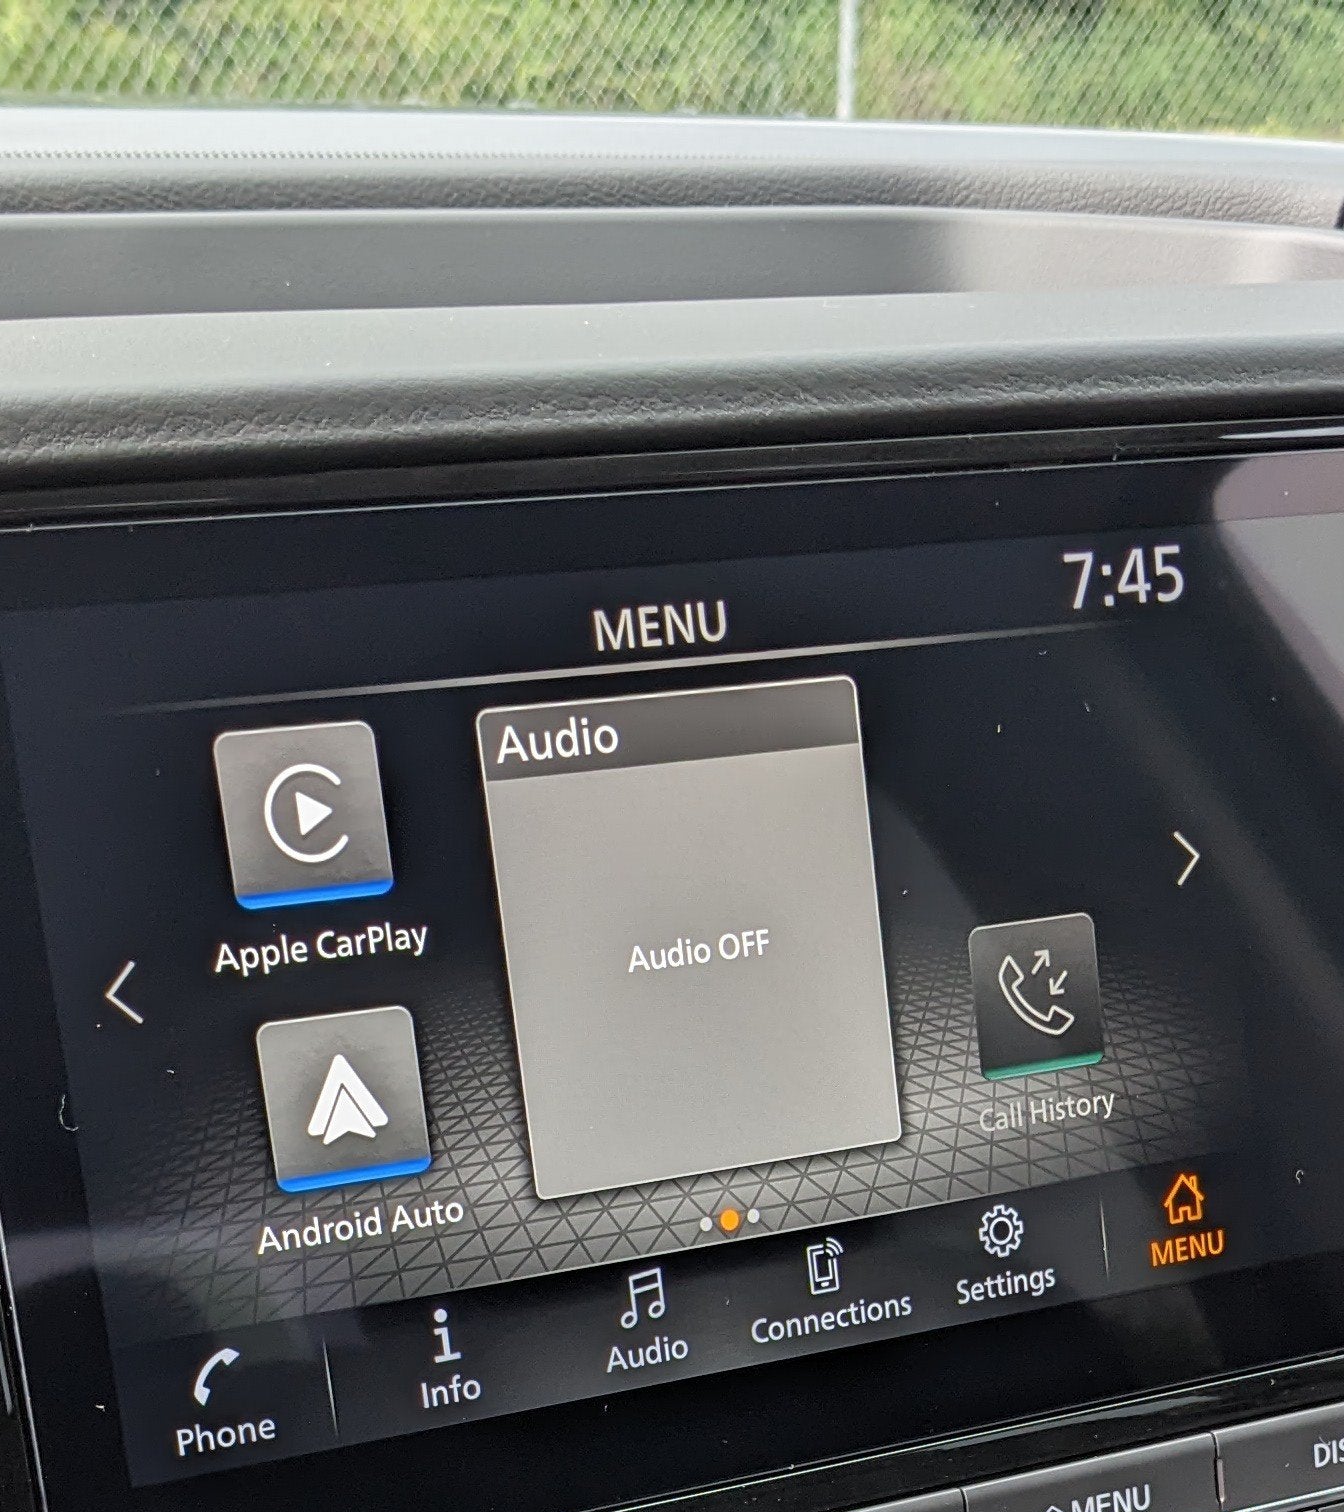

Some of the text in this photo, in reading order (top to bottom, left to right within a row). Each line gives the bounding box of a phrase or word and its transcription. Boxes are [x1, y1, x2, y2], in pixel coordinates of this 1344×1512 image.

[1062, 545, 1185, 609] 7:45
[592, 599, 727, 652] MENU
[496, 716, 619, 764] Audio
[214, 922, 428, 977] Apple CarPlay
[627, 929, 770, 974] Audio OFF
[979, 1092, 1115, 1132] Call History
[257, 1201, 464, 1254] Android Auto
[1150, 1229, 1225, 1267] MENU
[956, 1265, 1056, 1305] Settings
[751, 1294, 912, 1344] Connections
[606, 1336, 689, 1373] Audio
[420, 1374, 482, 1409] Info
[175, 1415, 276, 1456] Phone
